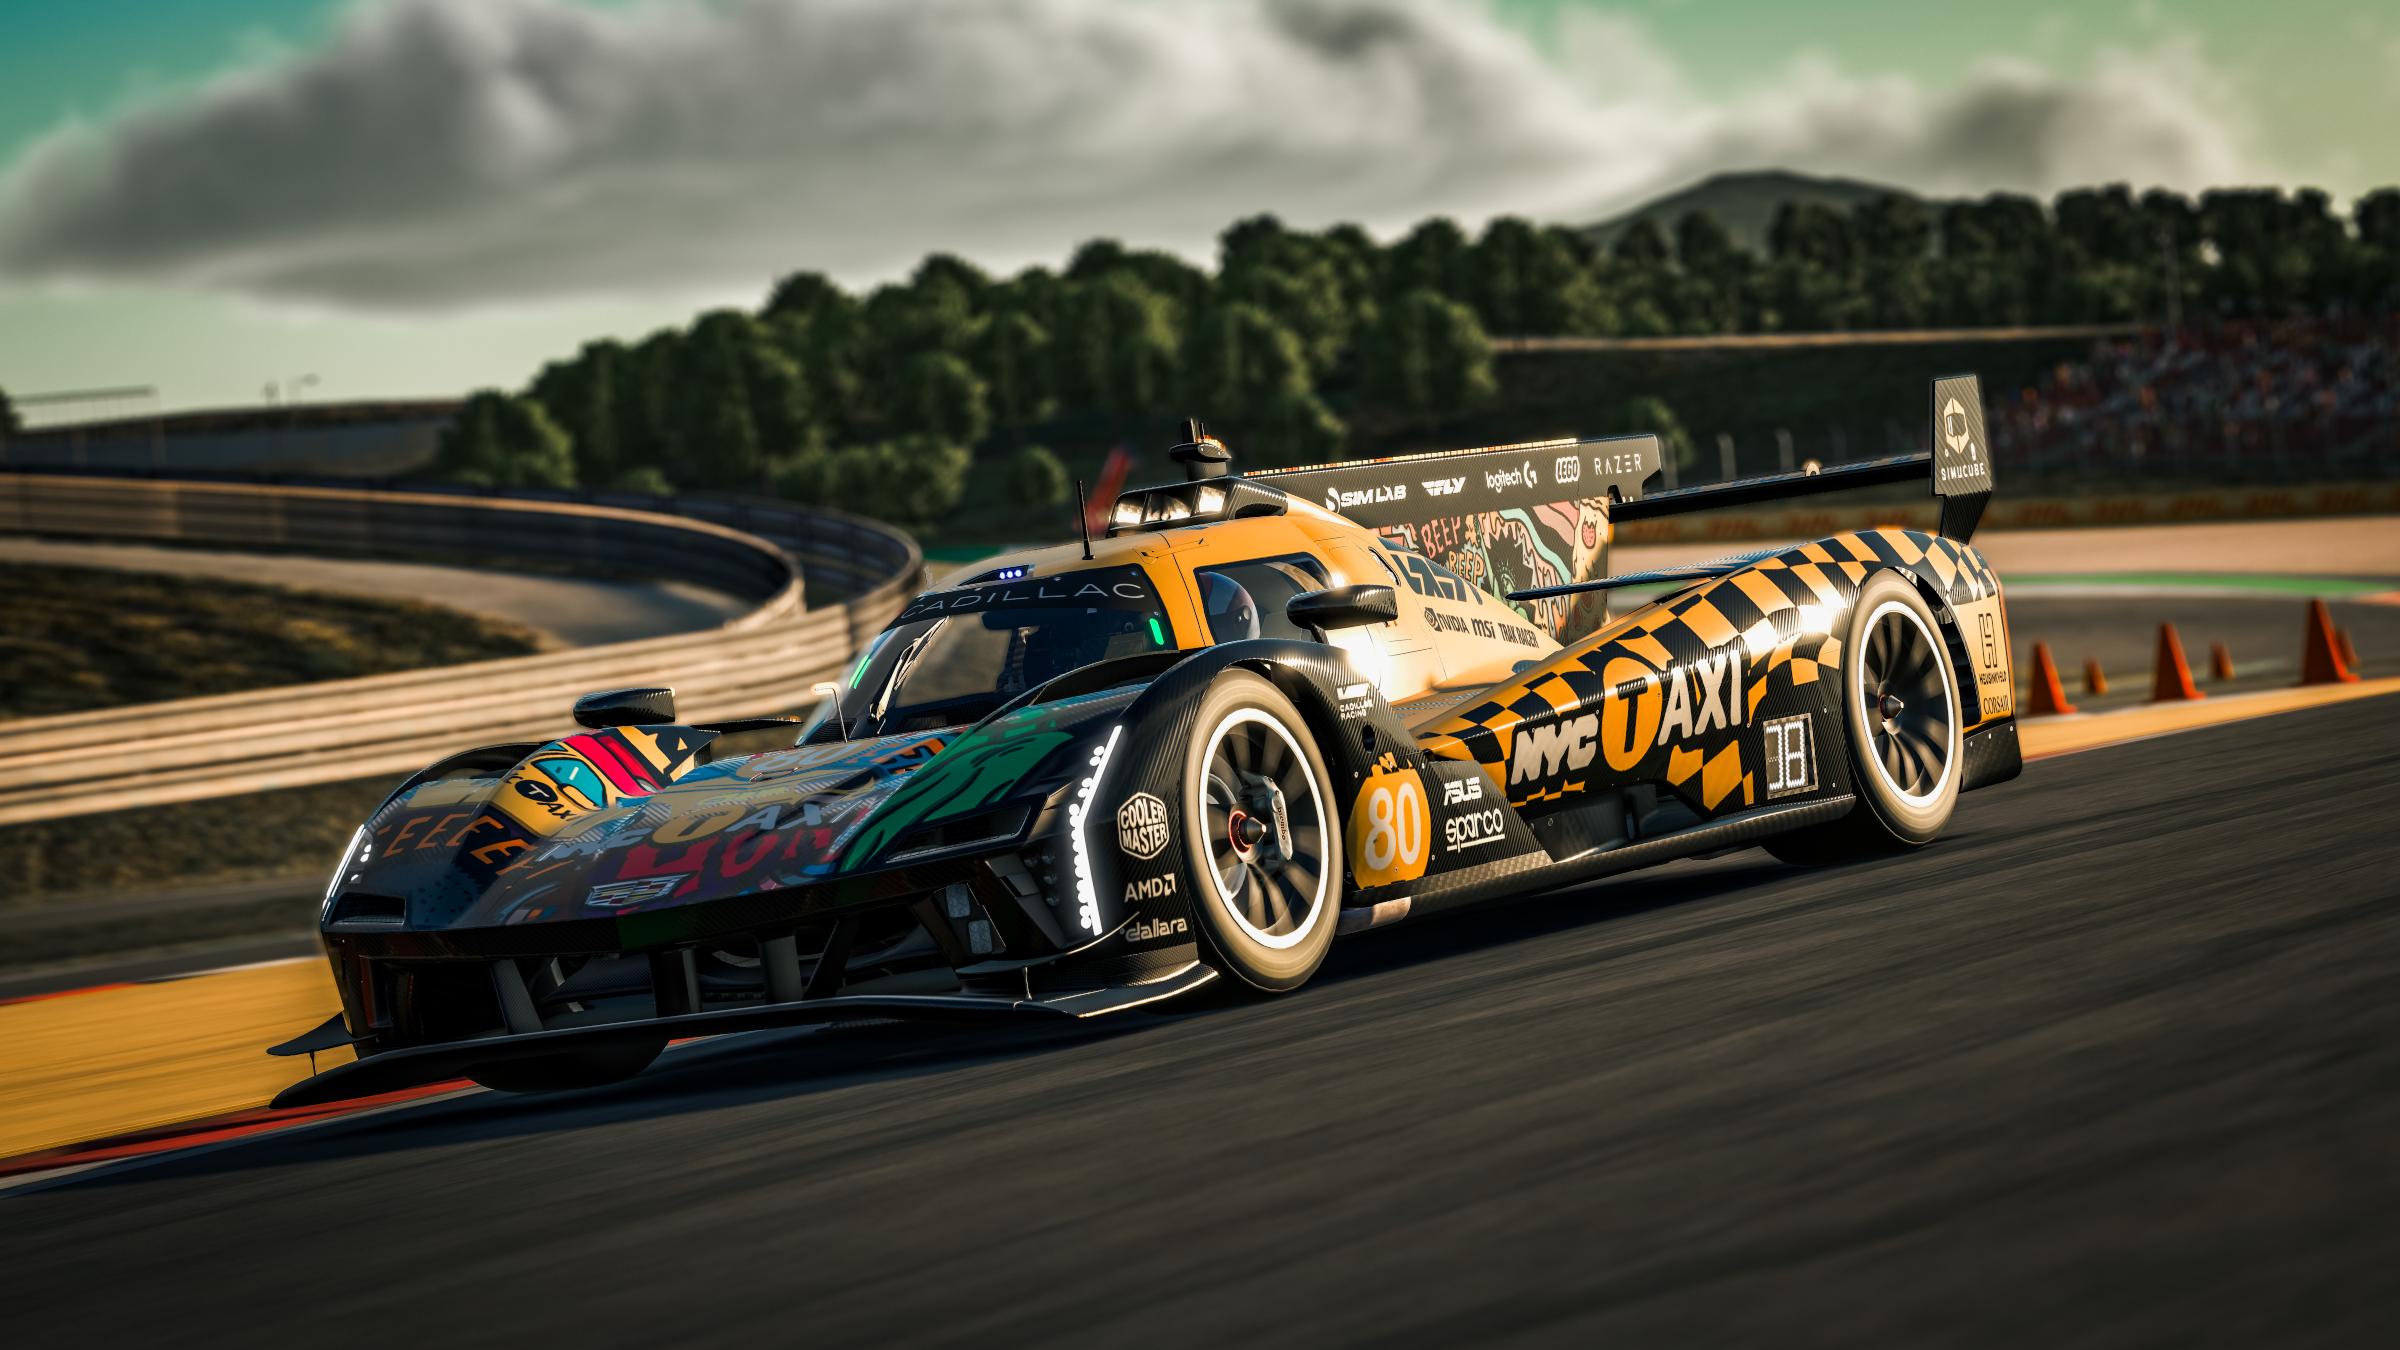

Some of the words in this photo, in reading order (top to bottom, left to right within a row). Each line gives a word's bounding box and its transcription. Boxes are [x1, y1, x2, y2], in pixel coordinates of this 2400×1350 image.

[1556, 456, 1581, 484] LEGO
[1594, 454, 1642, 476] RAZER
[1941, 463, 1985, 480] SIMUCUBE
[1486, 468, 1522, 493] logitech
[1341, 489, 1374, 507] SIM
[1376, 484, 1406, 502] LAB
[901, 583, 1145, 619] CADILLAC
[1437, 613, 1470, 634] NVIDIA
[1471, 618, 1496, 639] msi
[1511, 714, 1599, 785] NYC
[1617, 649, 1742, 753] TAXI
[1984, 695, 2010, 714] CORSAIR
[1444, 777, 1483, 806] ASUS
[1120, 798, 1165, 830] COOLER
[1365, 782, 1421, 871] 80
[1121, 823, 1167, 854] MASTER
[1446, 808, 1504, 853] sparco
[1124, 877, 1163, 903] AMD
[1124, 917, 1188, 942] dallara
